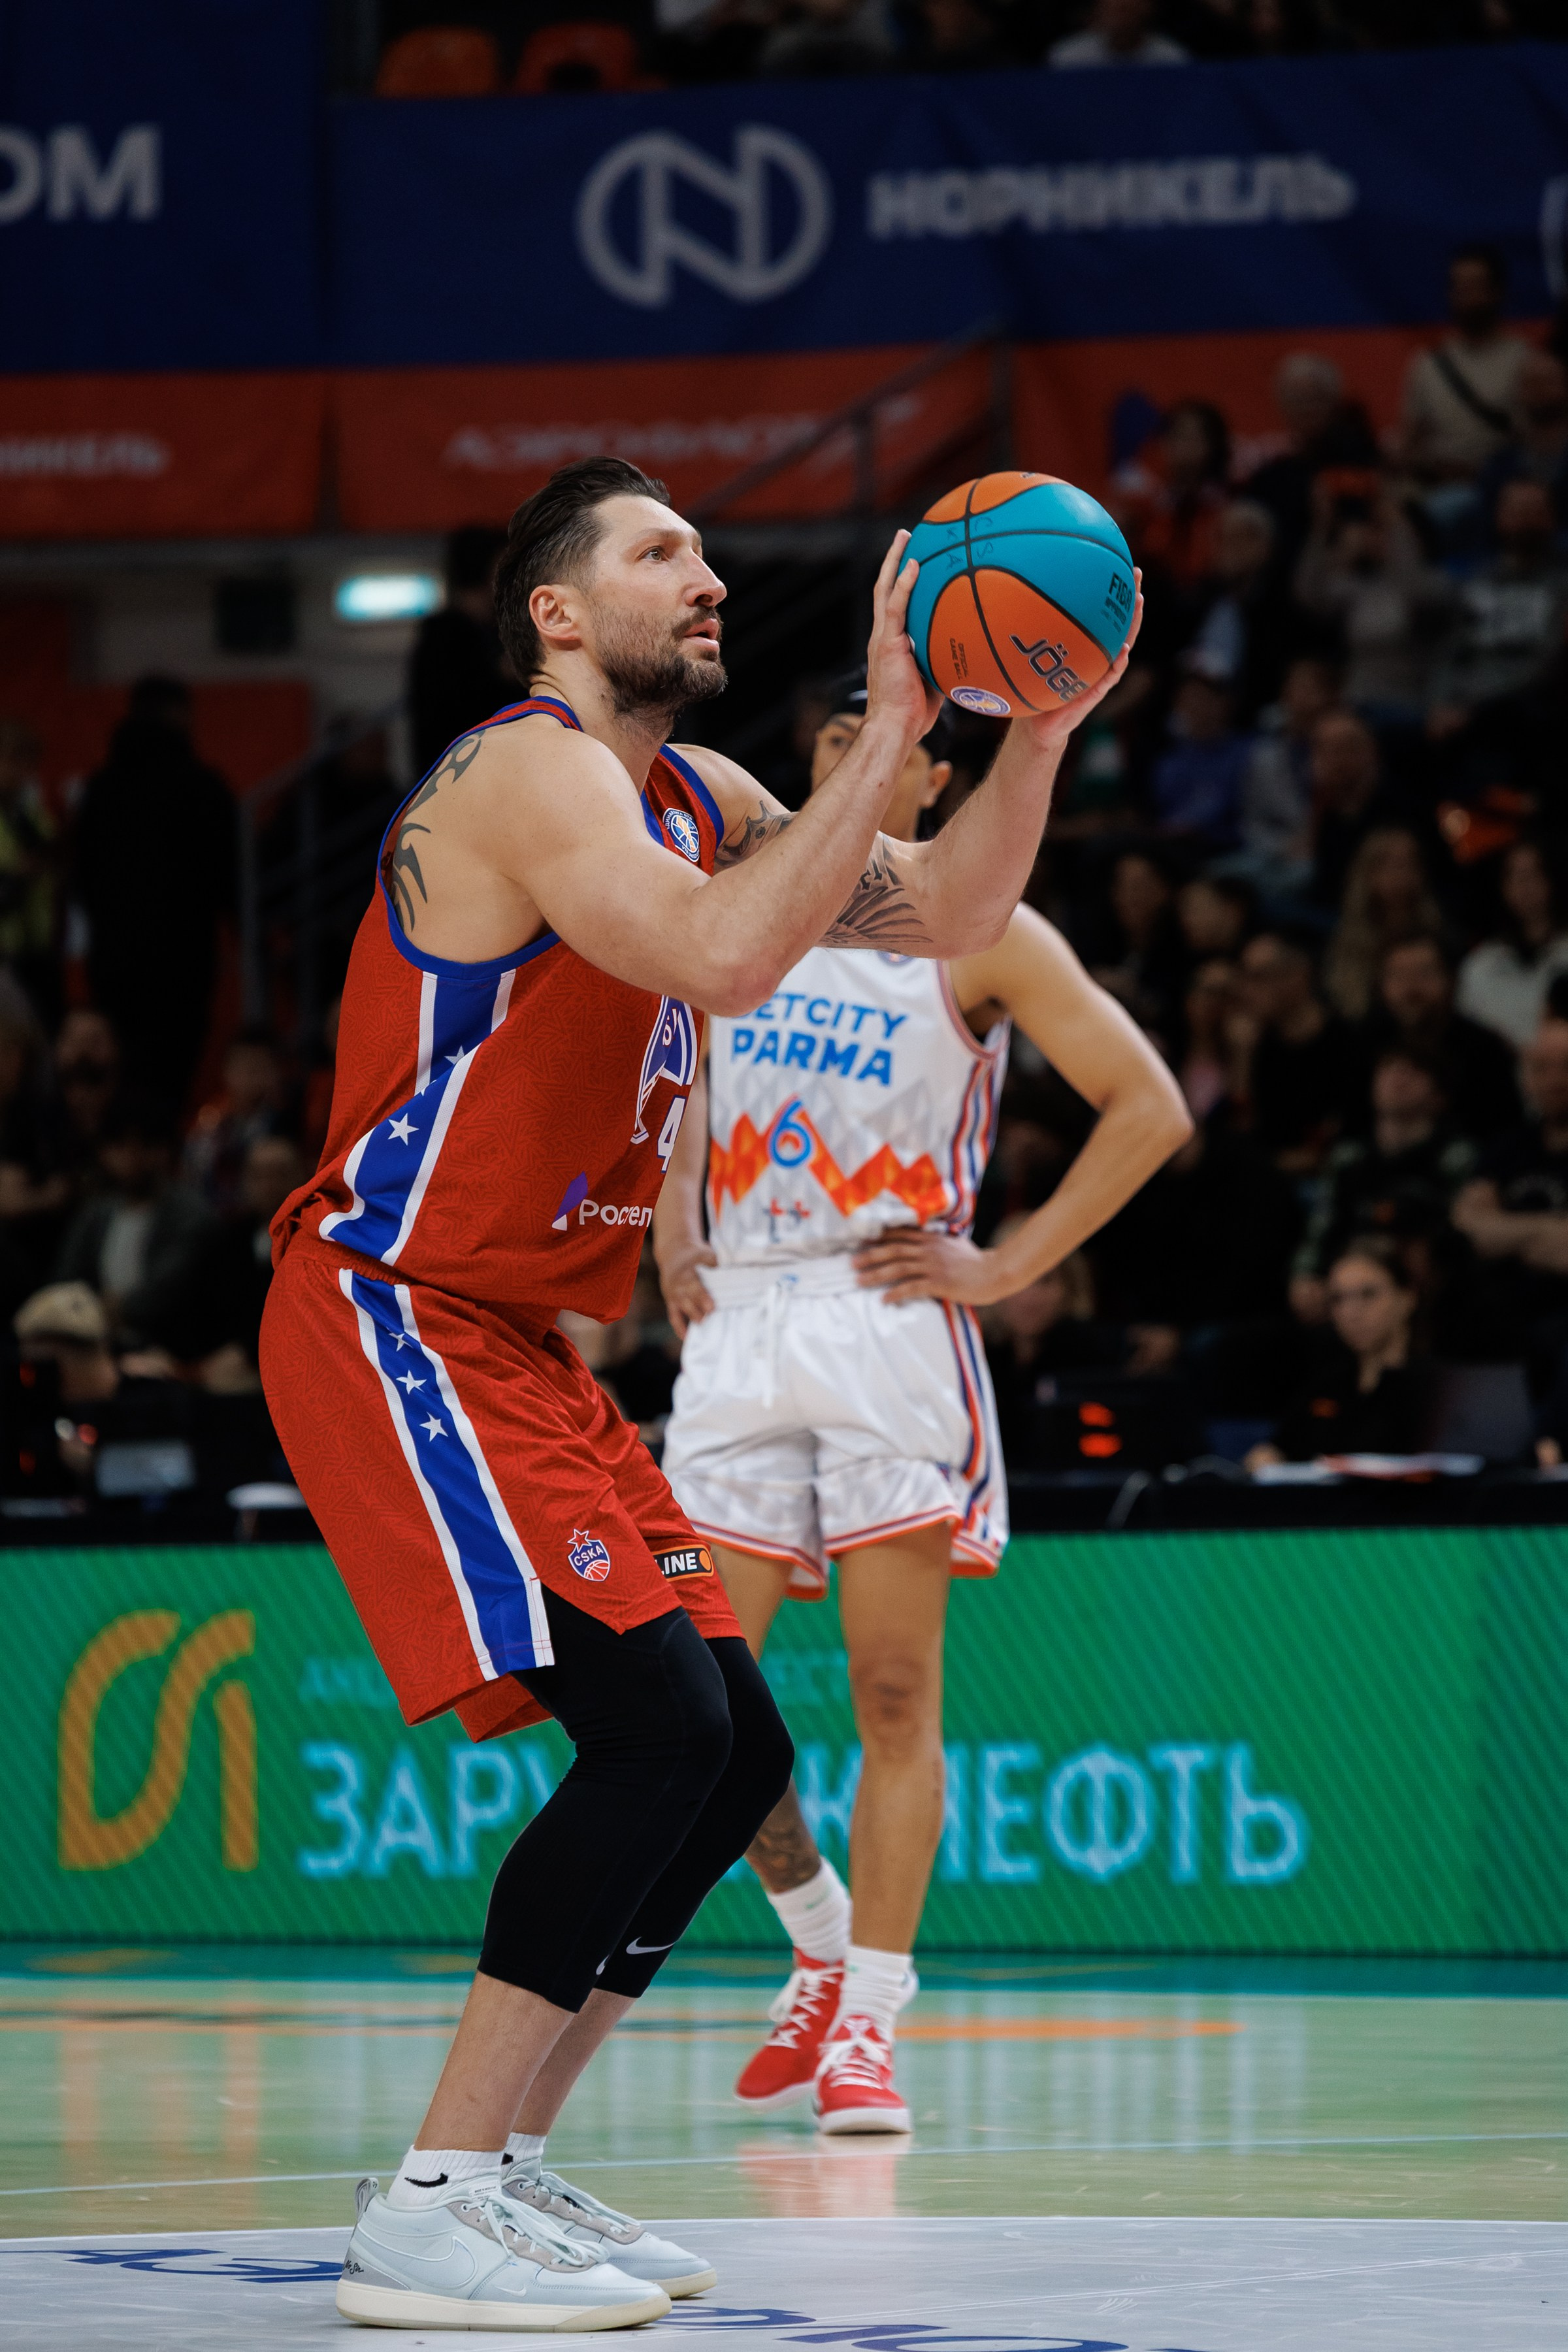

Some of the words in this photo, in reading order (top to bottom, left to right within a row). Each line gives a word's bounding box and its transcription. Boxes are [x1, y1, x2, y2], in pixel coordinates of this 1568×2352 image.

[866, 152, 1357, 238] НОРНИКЕЛЬ
[733, 992, 909, 1039] ETCITY
[731, 1028, 892, 1087] PARMA
[768, 1096, 814, 1168] 6
[574, 1545, 604, 1566] CSKA
